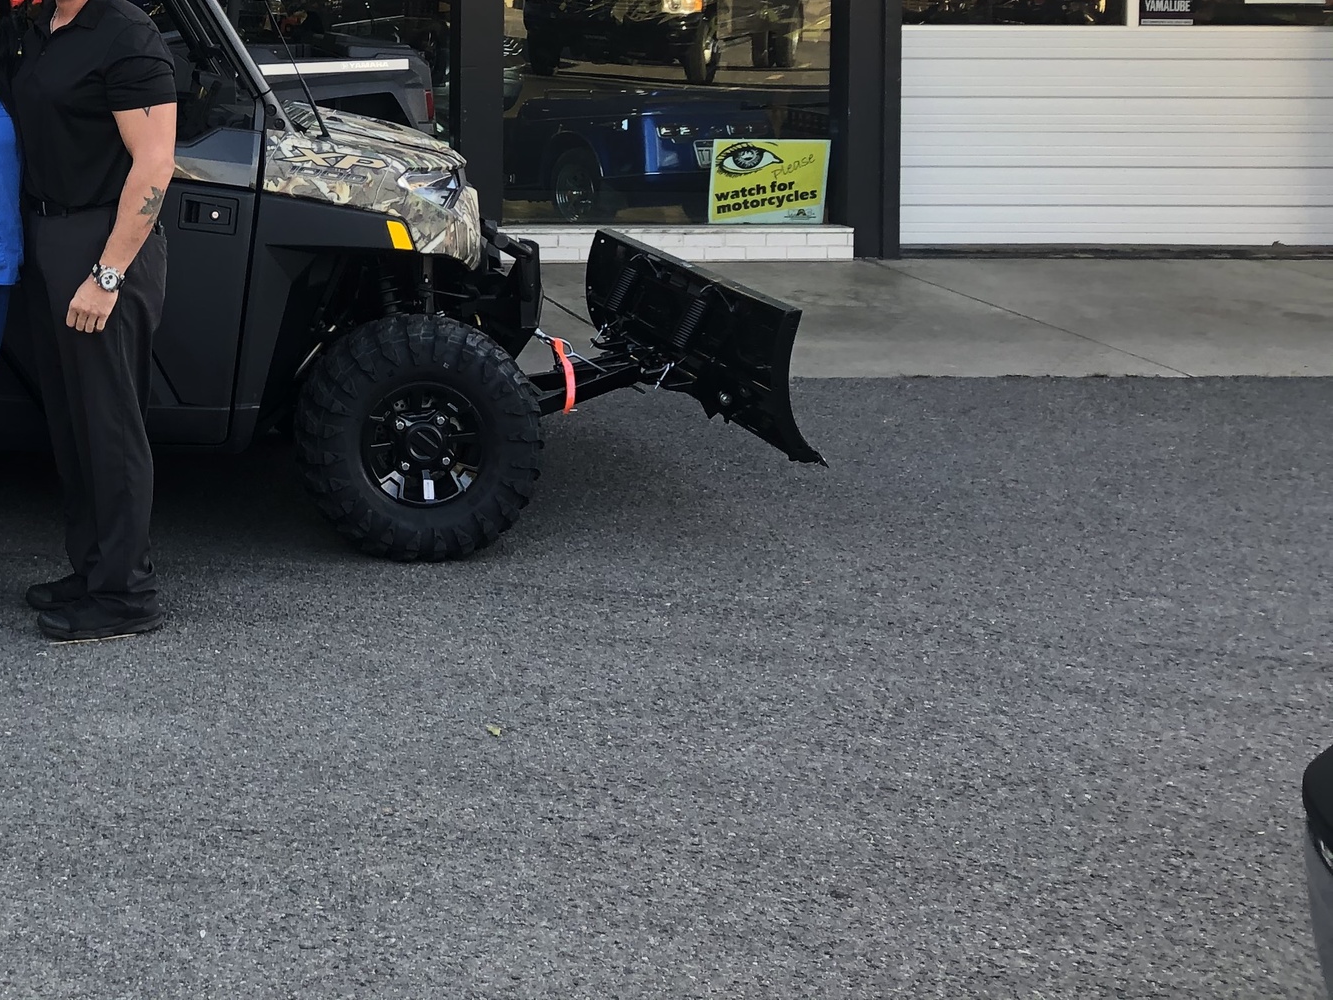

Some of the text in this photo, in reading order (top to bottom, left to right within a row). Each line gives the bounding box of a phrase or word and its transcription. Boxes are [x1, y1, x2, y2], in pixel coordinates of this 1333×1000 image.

[1144, 0, 1191, 12] YAMALUBE
[349, 61, 389, 69] YAMAHA
[274, 145, 389, 170] XP
[771, 153, 816, 180] please
[715, 180, 795, 202] watch for
[716, 189, 818, 215] motorcycles
